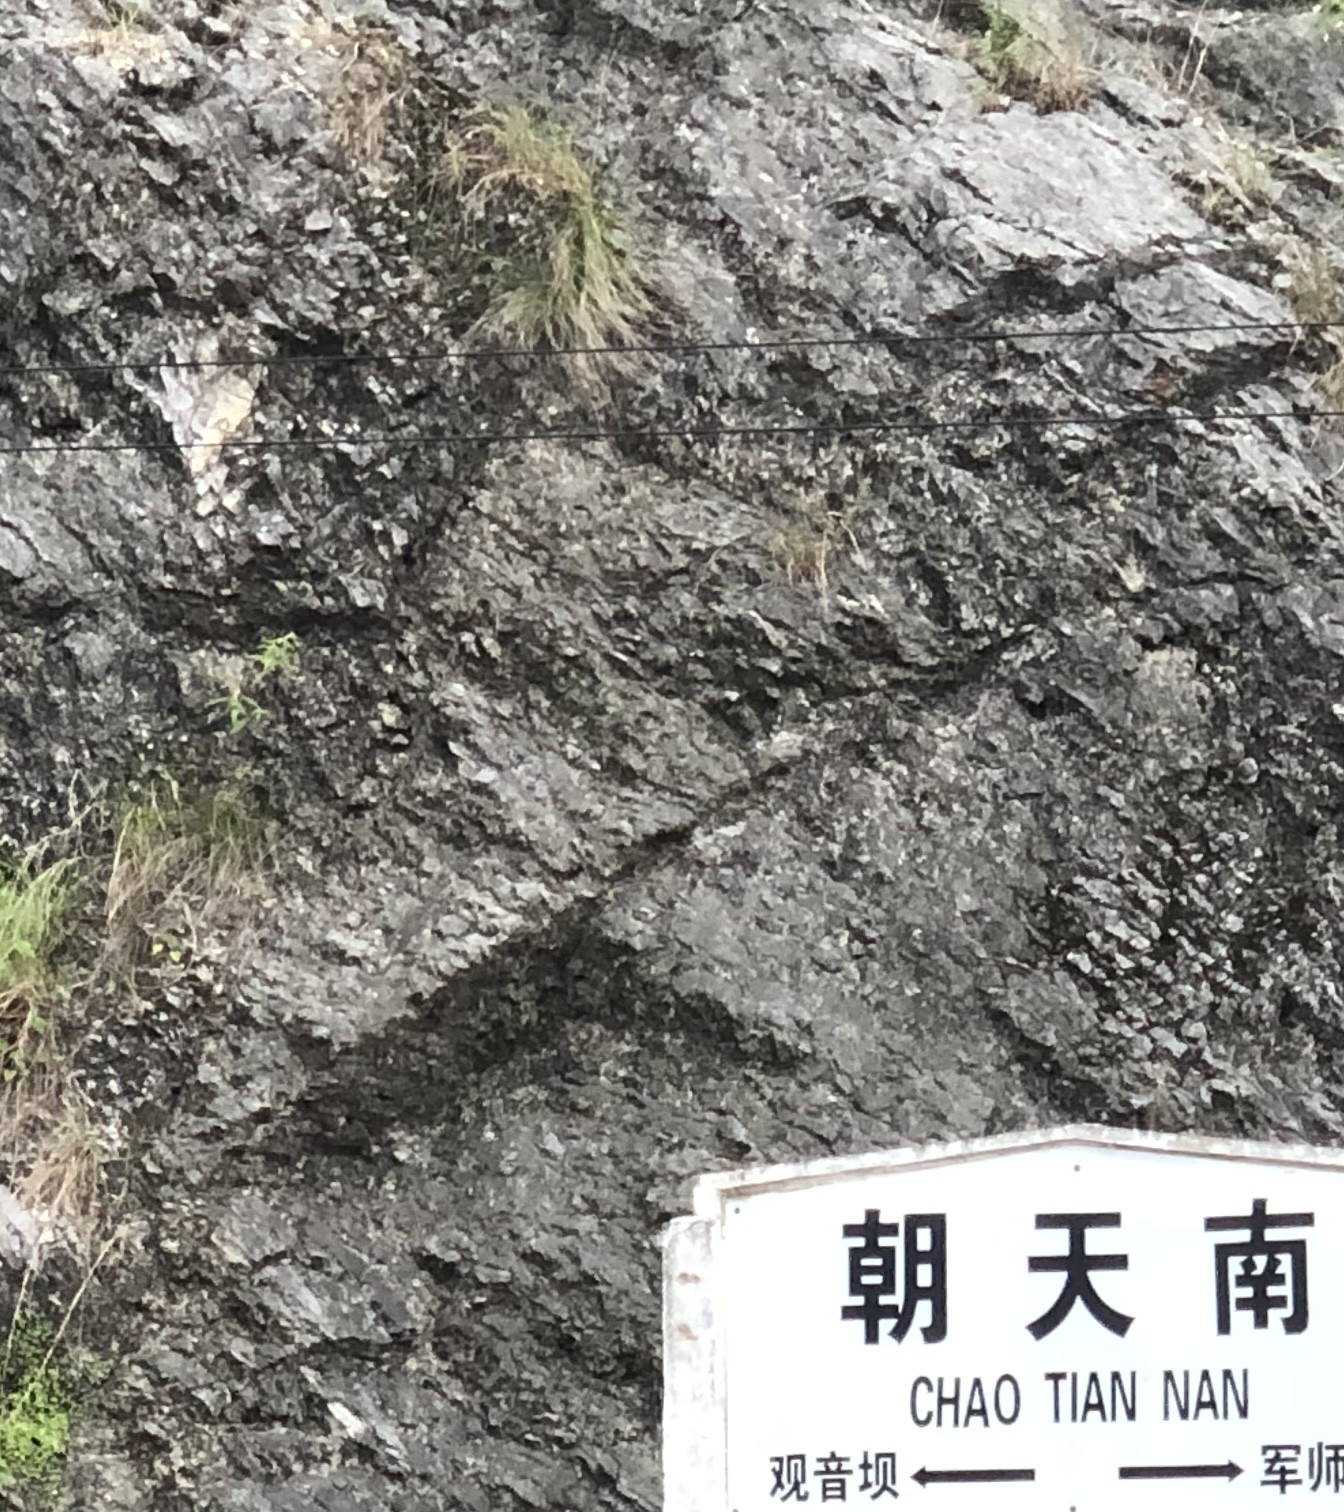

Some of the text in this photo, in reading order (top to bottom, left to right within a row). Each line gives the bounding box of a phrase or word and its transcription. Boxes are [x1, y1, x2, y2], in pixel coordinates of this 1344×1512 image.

[840, 1198, 1316, 1346] 朝天南
[909, 1367, 1250, 1428] CHAO TIAN NAN
[769, 1450, 900, 1503] 观音坝
